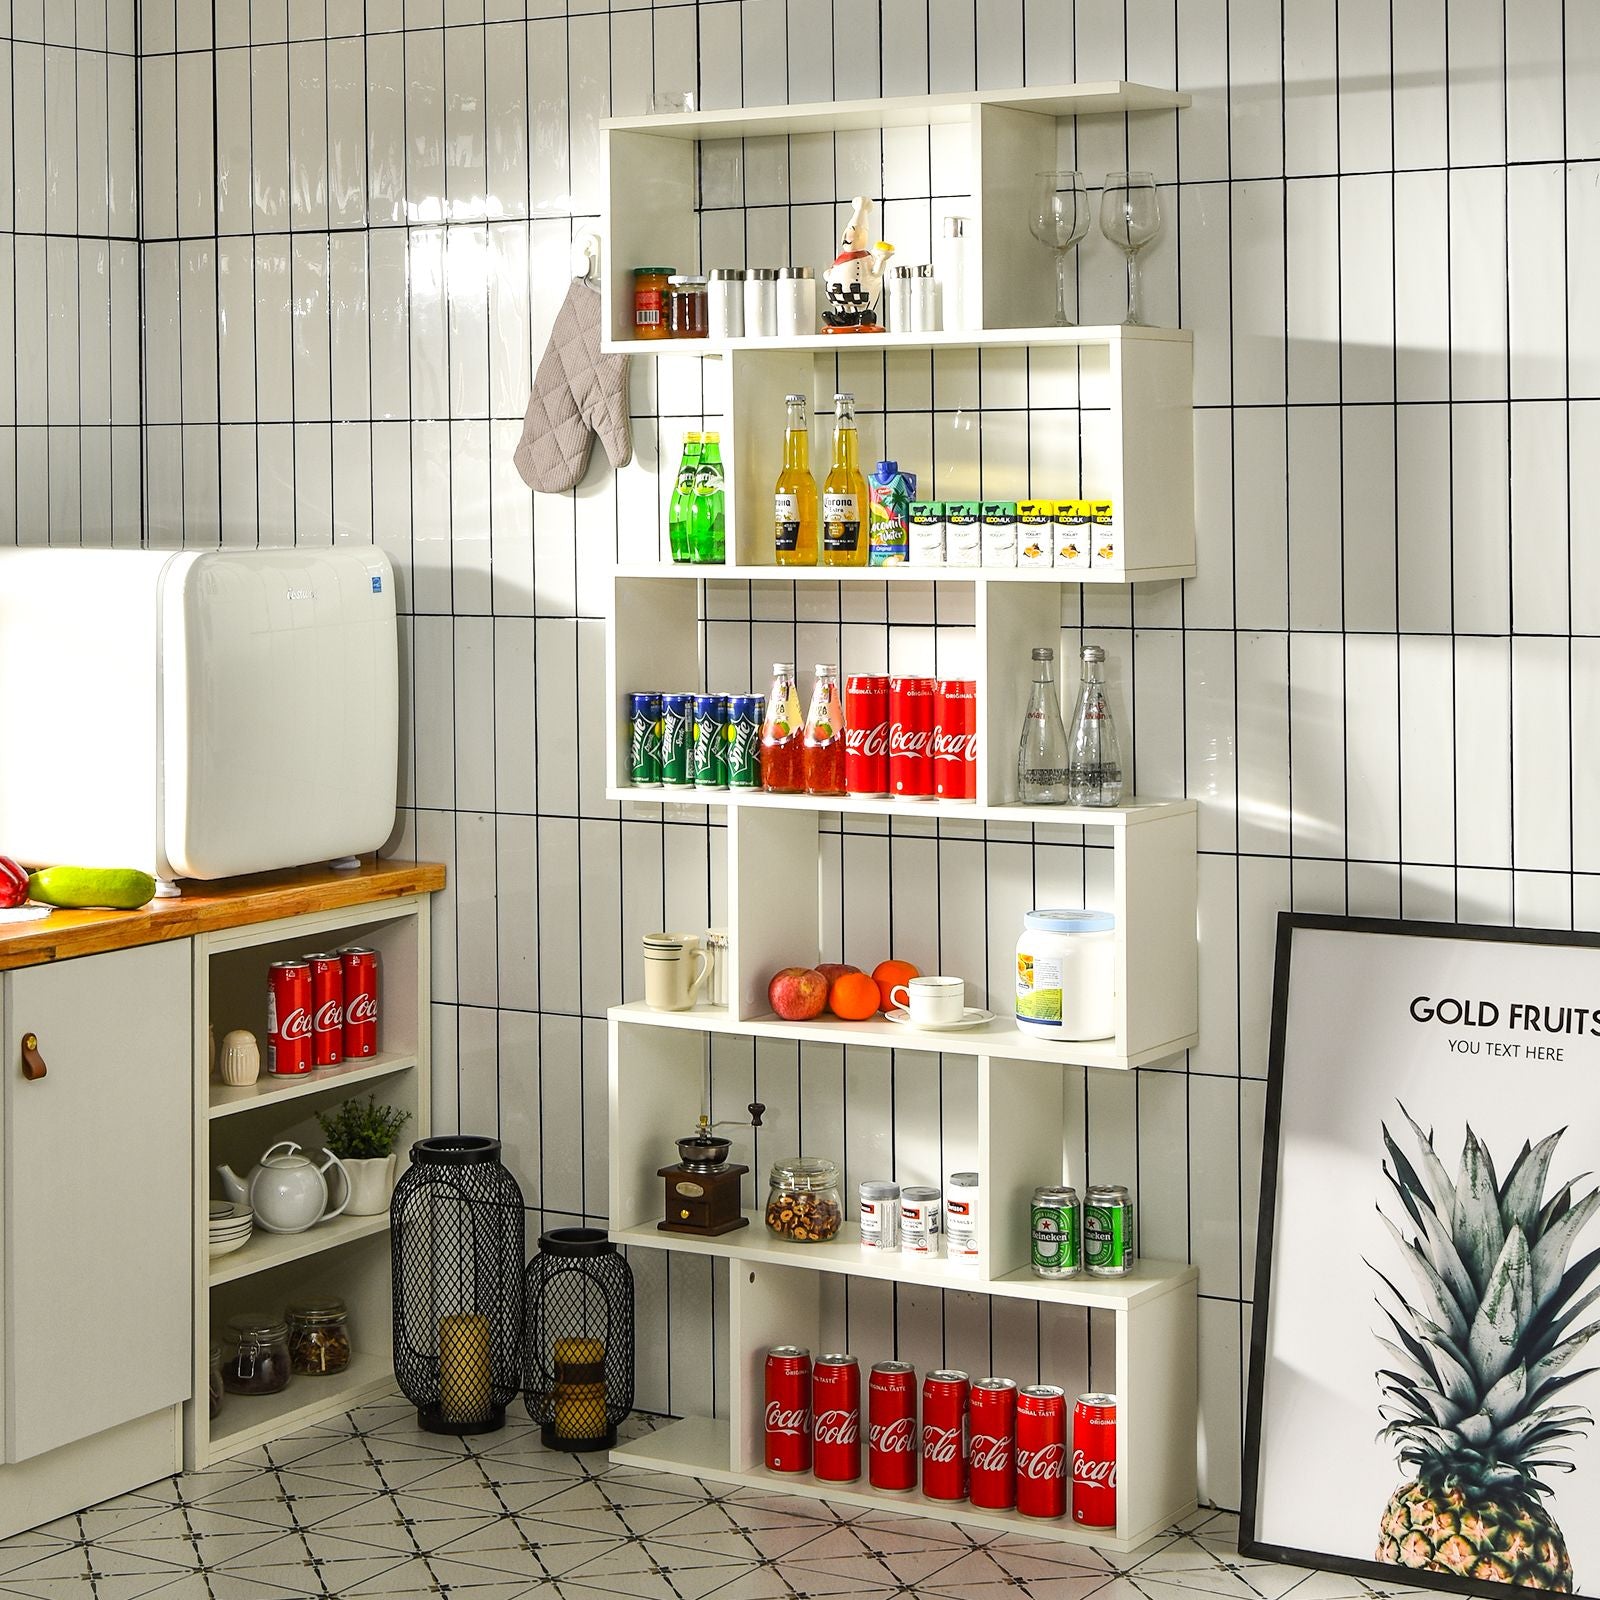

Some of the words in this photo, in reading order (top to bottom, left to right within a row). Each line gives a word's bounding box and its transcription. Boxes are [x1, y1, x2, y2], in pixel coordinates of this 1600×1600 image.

[870, 514, 905, 533] oconut
[1410, 996, 1499, 1027] GOLD
[1509, 1003, 1600, 1037] FRUITS
[1448, 1039, 1480, 1055] YOU
[1485, 1042, 1521, 1058] TEXT
[1525, 1045, 1565, 1062] HERE
